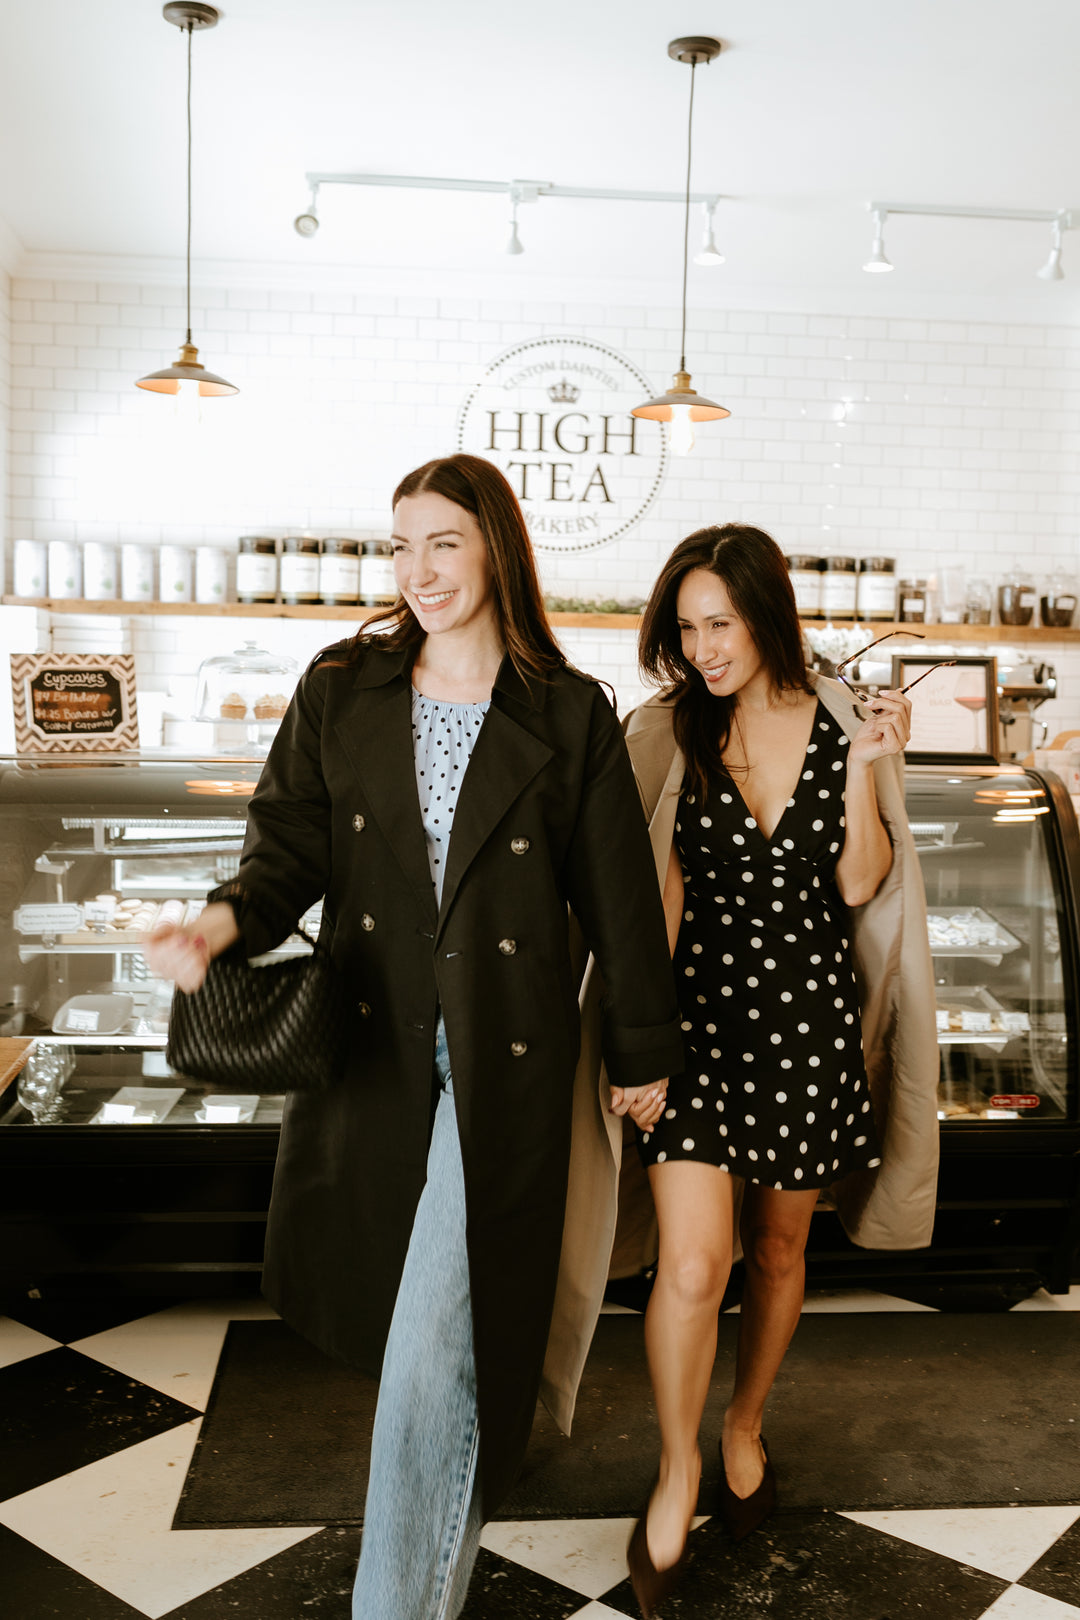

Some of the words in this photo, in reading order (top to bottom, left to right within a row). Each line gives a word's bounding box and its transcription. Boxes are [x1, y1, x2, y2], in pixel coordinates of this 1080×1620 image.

[503, 360, 556, 391] CUSTOM
[559, 360, 620, 392] DAINTIES
[484, 410, 641, 455] HIGH
[507, 461, 615, 502] TEA
[526, 511, 600, 534] BAKERY
[44, 673, 105, 690] Cupcakes
